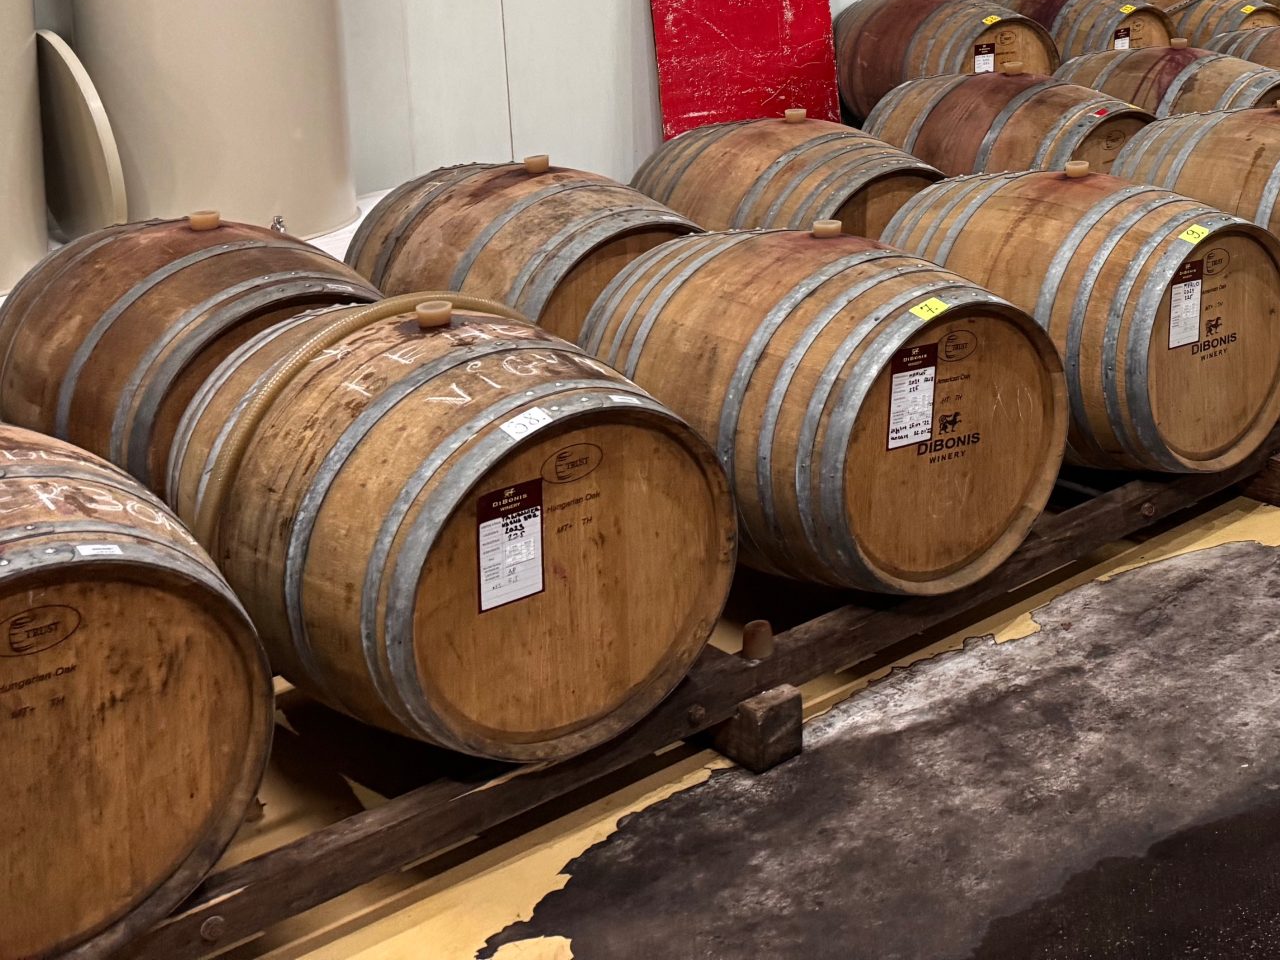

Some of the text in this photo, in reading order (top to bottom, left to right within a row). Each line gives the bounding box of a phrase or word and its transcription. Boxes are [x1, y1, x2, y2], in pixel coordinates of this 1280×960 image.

[1191, 332, 1237, 355] DIBONIS
[1200, 348, 1228, 361] WINERY
[917, 432, 980, 456] DIBONIS
[929, 449, 965, 464] WINERY
